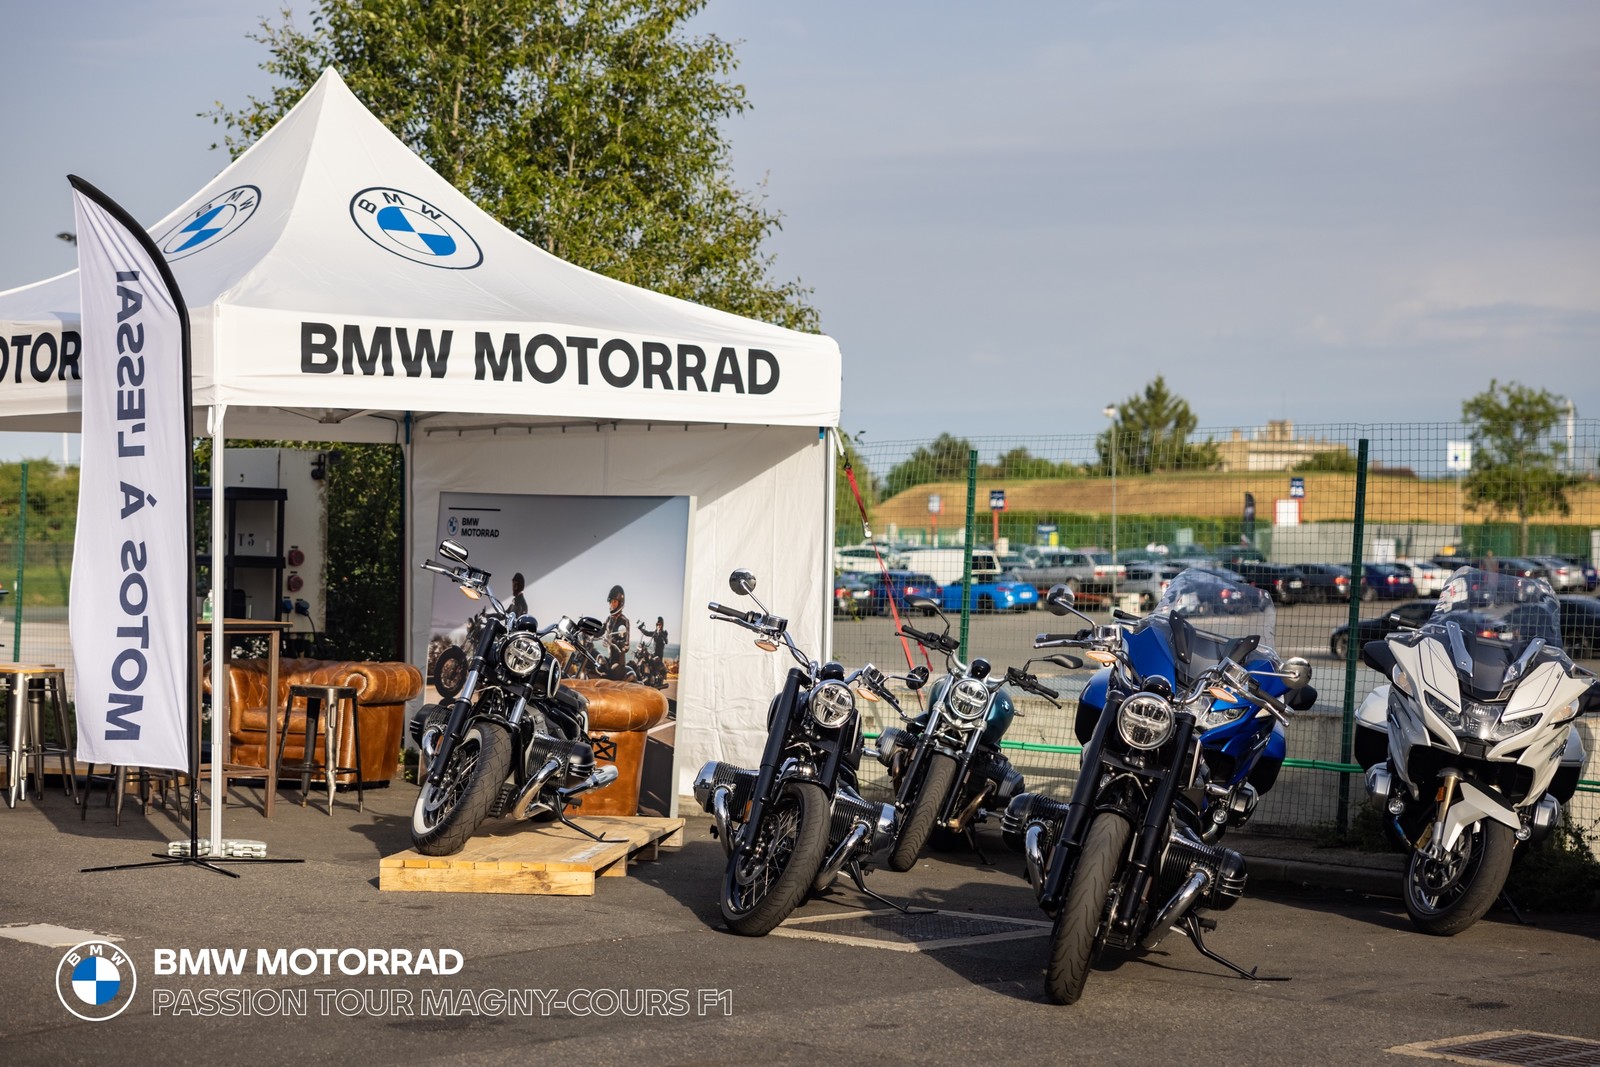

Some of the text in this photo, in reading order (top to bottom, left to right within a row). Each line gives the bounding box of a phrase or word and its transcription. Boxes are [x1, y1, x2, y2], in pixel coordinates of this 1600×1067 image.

[195, 189, 255, 218] BMW
[358, 191, 442, 221] BMW
[301, 321, 781, 395] BMW MOTORRAD
[461, 528, 500, 538] MOTORRAD
[462, 517, 479, 526] BMW
